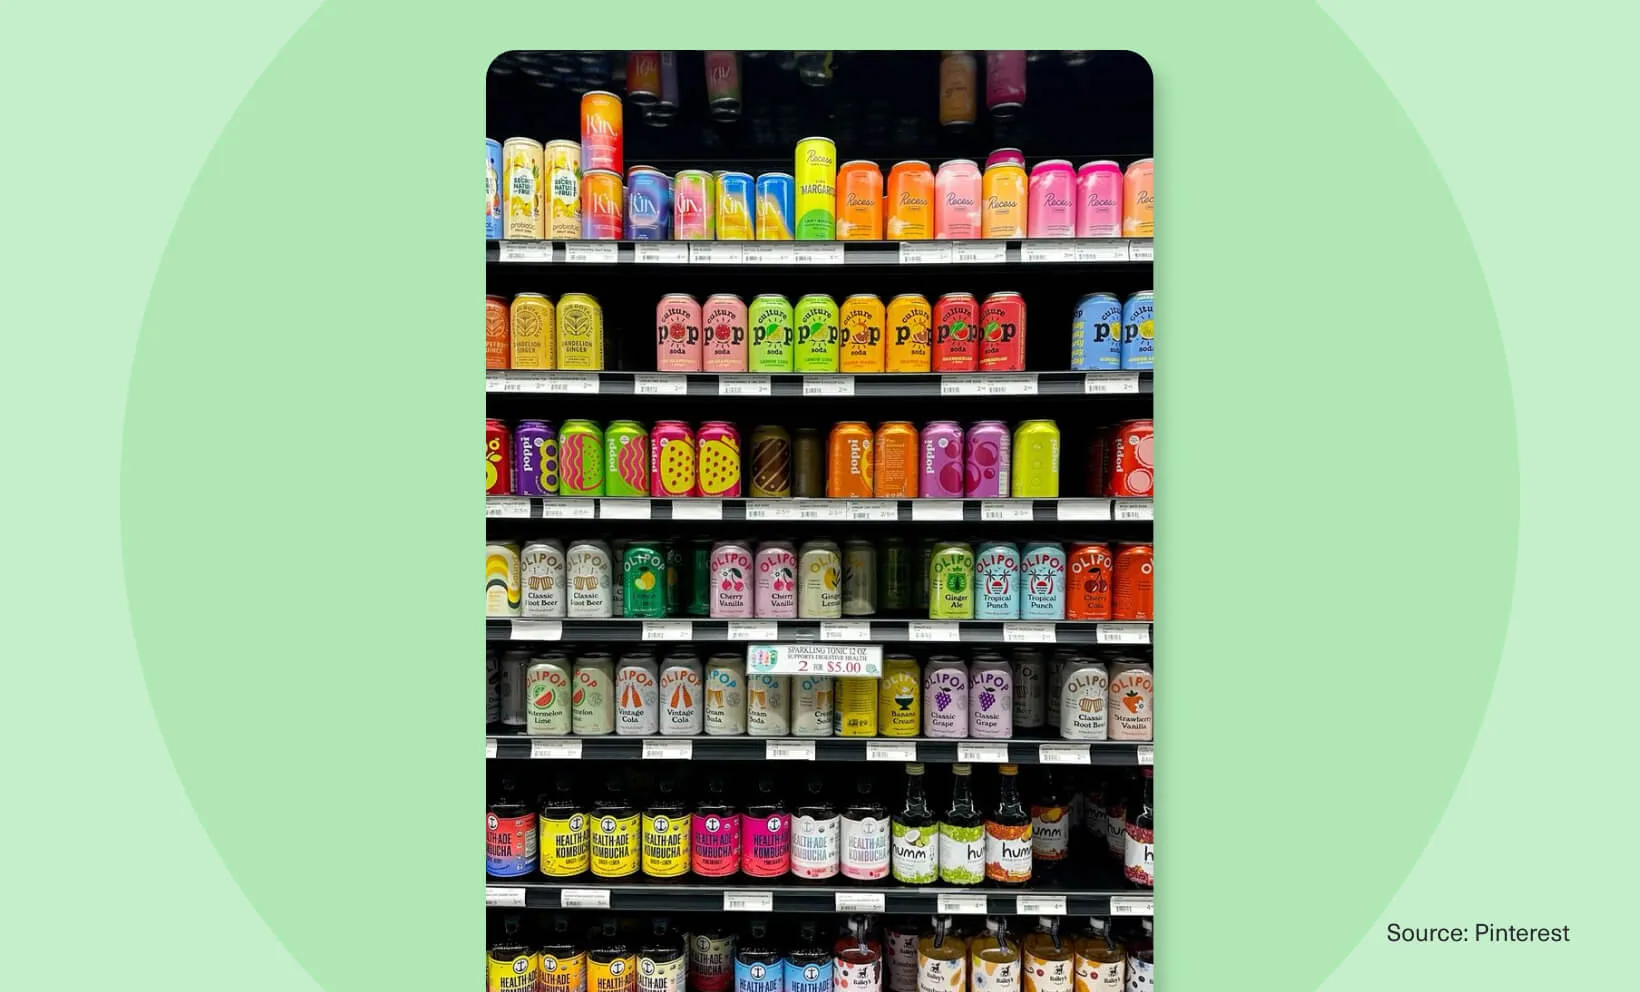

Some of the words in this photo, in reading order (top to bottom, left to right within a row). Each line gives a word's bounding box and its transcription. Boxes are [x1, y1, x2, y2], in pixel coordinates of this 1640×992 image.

[806, 149, 833, 164] Recess
[801, 184, 837, 196] MARGAR
[1136, 190, 1154, 205] Rec
[847, 192, 875, 206] Recess
[899, 192, 928, 206] Recess
[945, 191, 975, 206] Recess
[987, 195, 1017, 209] Recess
[1043, 192, 1073, 207] Recess
[1087, 193, 1117, 207] Recess
[661, 307, 691, 323] culture
[707, 308, 737, 324] culture
[758, 309, 788, 324] culture
[802, 308, 832, 323] culture
[843, 309, 873, 326] culture
[943, 307, 972, 322] culture
[1130, 305, 1153, 322] cultu
[521, 436, 533, 472] poppi
[607, 438, 618, 473] poppi
[848, 439, 861, 475] poppi
[924, 439, 936, 474] poppi
[1114, 439, 1124, 472] poppi
[521, 553, 563, 573] OLIPOP
[567, 552, 609, 573] OLIPOP
[623, 553, 666, 573] OLIPOP
[711, 553, 753, 573] OLIPOP
[760, 553, 799, 573] OLIPO
[934, 554, 974, 573] OLIPO
[976, 554, 1019, 573] OLIPOP
[1021, 554, 1065, 573] OLIPOP
[1071, 553, 1113, 574] OLIPO
[527, 592, 554, 600] Classic
[945, 594, 968, 602] Ginger
[983, 594, 1012, 603] Tropical
[1027, 594, 1057, 602] Tropical
[787, 647, 827, 655] SPARKLING
[827, 647, 849, 655] TONIC
[799, 660, 809, 672] 2
[813, 663, 824, 671] FOR
[827, 661, 862, 673] $5.00
[660, 670, 701, 688] OLIPOP
[882, 672, 917, 690] OLIPO
[925, 673, 965, 691] OLIPOP
[969, 673, 1009, 691] OLIPOP
[618, 708, 645, 717] Vintage
[667, 709, 694, 717] Vintage
[930, 712, 956, 720] Classic
[974, 712, 1000, 720] Classic
[932, 719, 954, 727] Grape
[975, 719, 998, 727] Grape
[1073, 721, 1092, 729] Root
[1121, 721, 1147, 730] Vanilla
[1032, 827, 1062, 837] umm
[556, 843, 590, 859] KOMBUC
[592, 845, 630, 859] KOMBUCHA
[644, 845, 682, 859] KOMBUCHA
[696, 846, 732, 857] KOMBUCHA
[753, 844, 790, 859] KOMBUC
[848, 848, 887, 862] KOMBUCHA
[892, 842, 926, 860] humm
[967, 844, 985, 860] hu
[500, 967, 539, 989] HEALTH-AD
